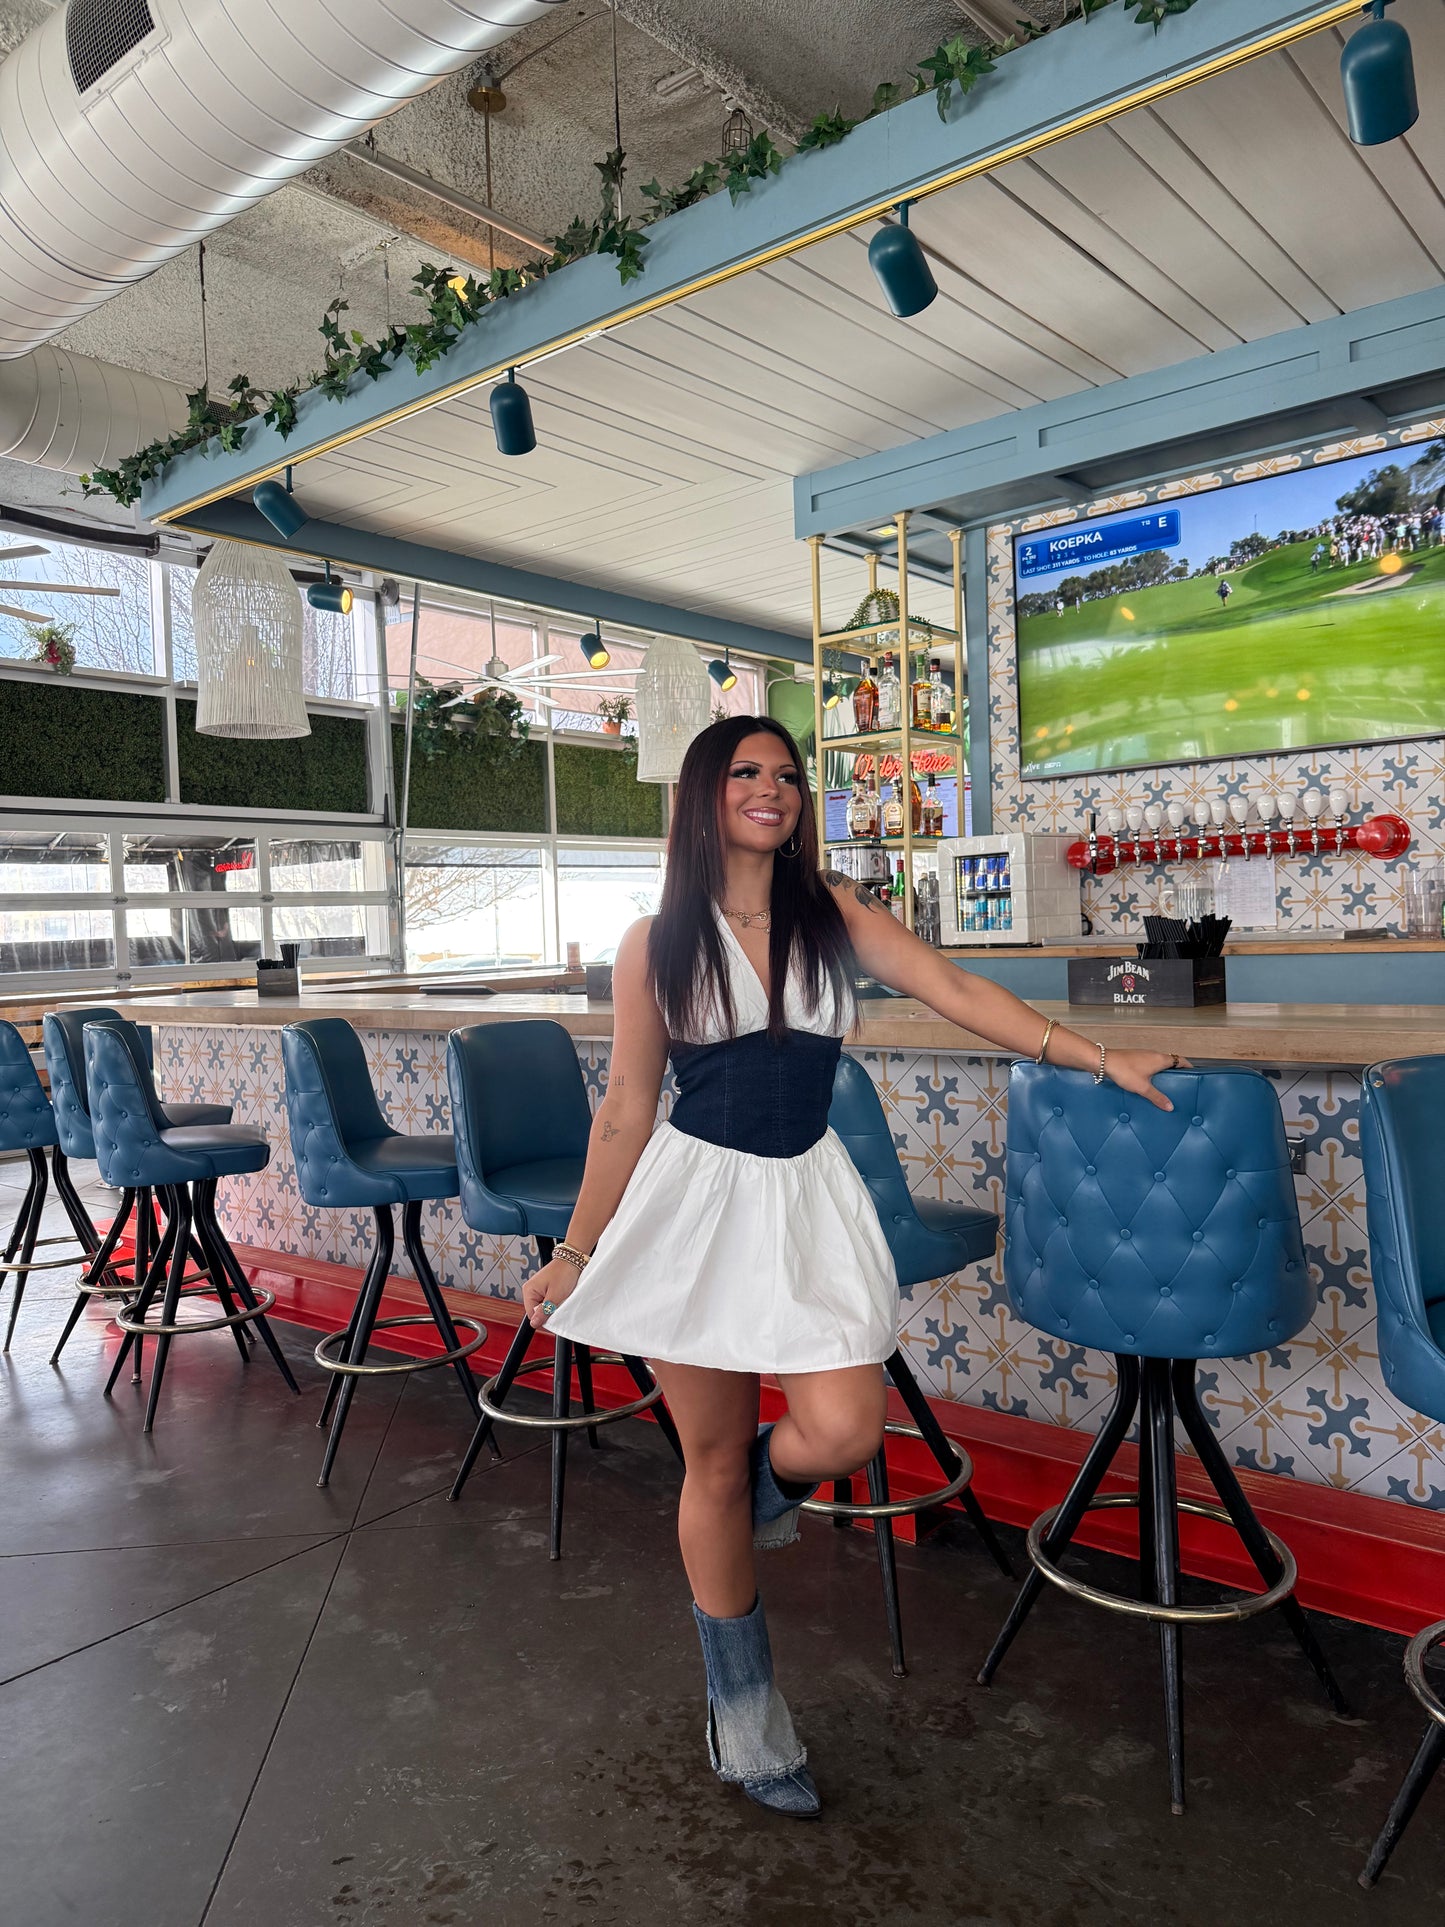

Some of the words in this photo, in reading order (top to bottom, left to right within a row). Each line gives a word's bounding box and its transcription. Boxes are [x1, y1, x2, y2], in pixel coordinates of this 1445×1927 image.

[1158, 516, 1167, 528] E
[1025, 547, 1032, 556] 2
[1050, 531, 1102, 552] KOEPKA
[1023, 567, 1036, 575] LAST
[1036, 564, 1051, 573] SHOT:
[1061, 557, 1080, 567] YARDS
[1092, 551, 1108, 560] HOLE:
[1117, 545, 1137, 554] YARDS
[910, 750, 952, 773] Here
[1107, 964, 1124, 982] JIM
[1124, 961, 1150, 982] BEAM
[1113, 993, 1146, 1004] BLACK
